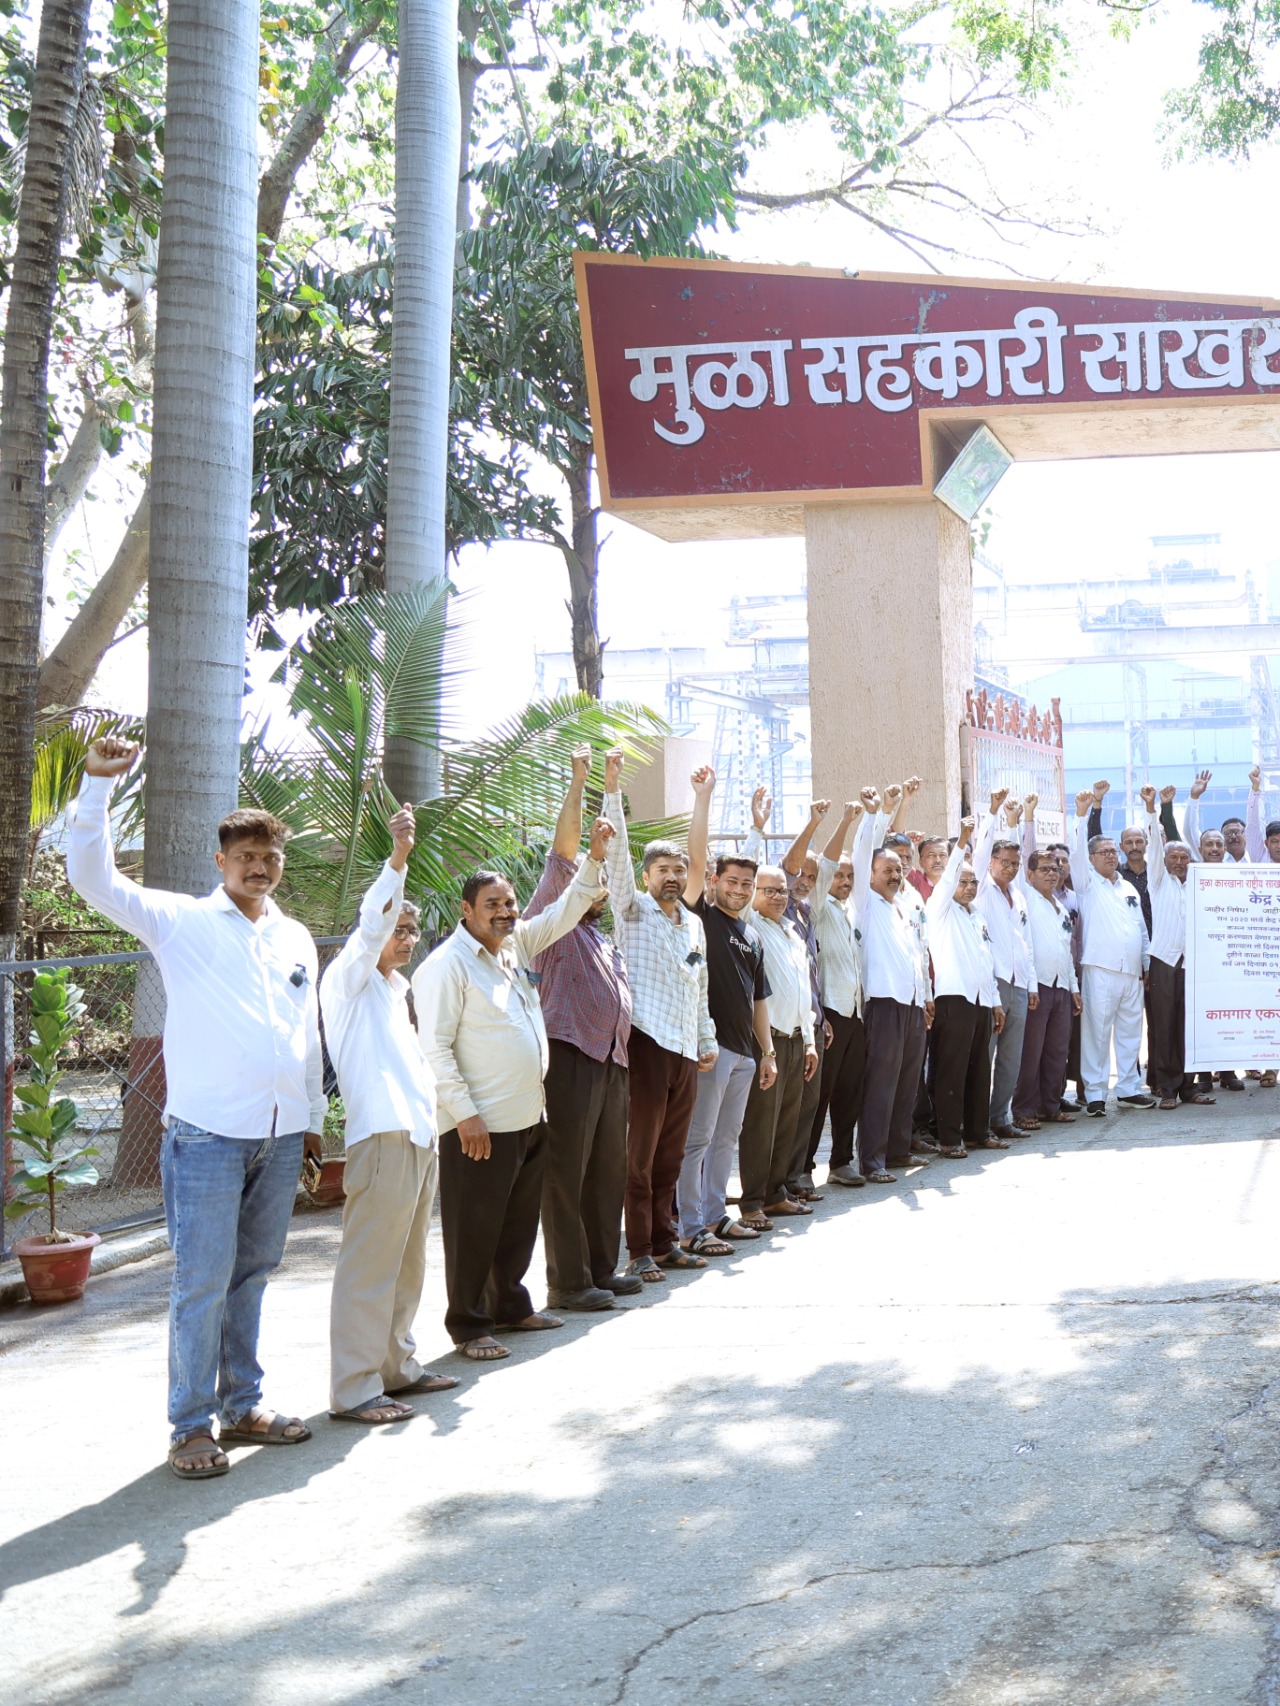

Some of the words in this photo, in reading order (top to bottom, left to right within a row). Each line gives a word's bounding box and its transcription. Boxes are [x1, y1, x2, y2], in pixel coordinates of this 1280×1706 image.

[625, 339, 792, 445] मुळा
[800, 307, 1067, 412] सहकारी
[1214, 879, 1244, 889] कारखाना
[1248, 891, 1272, 906] केंद्र
[1205, 1009, 1252, 1020] कामगार
